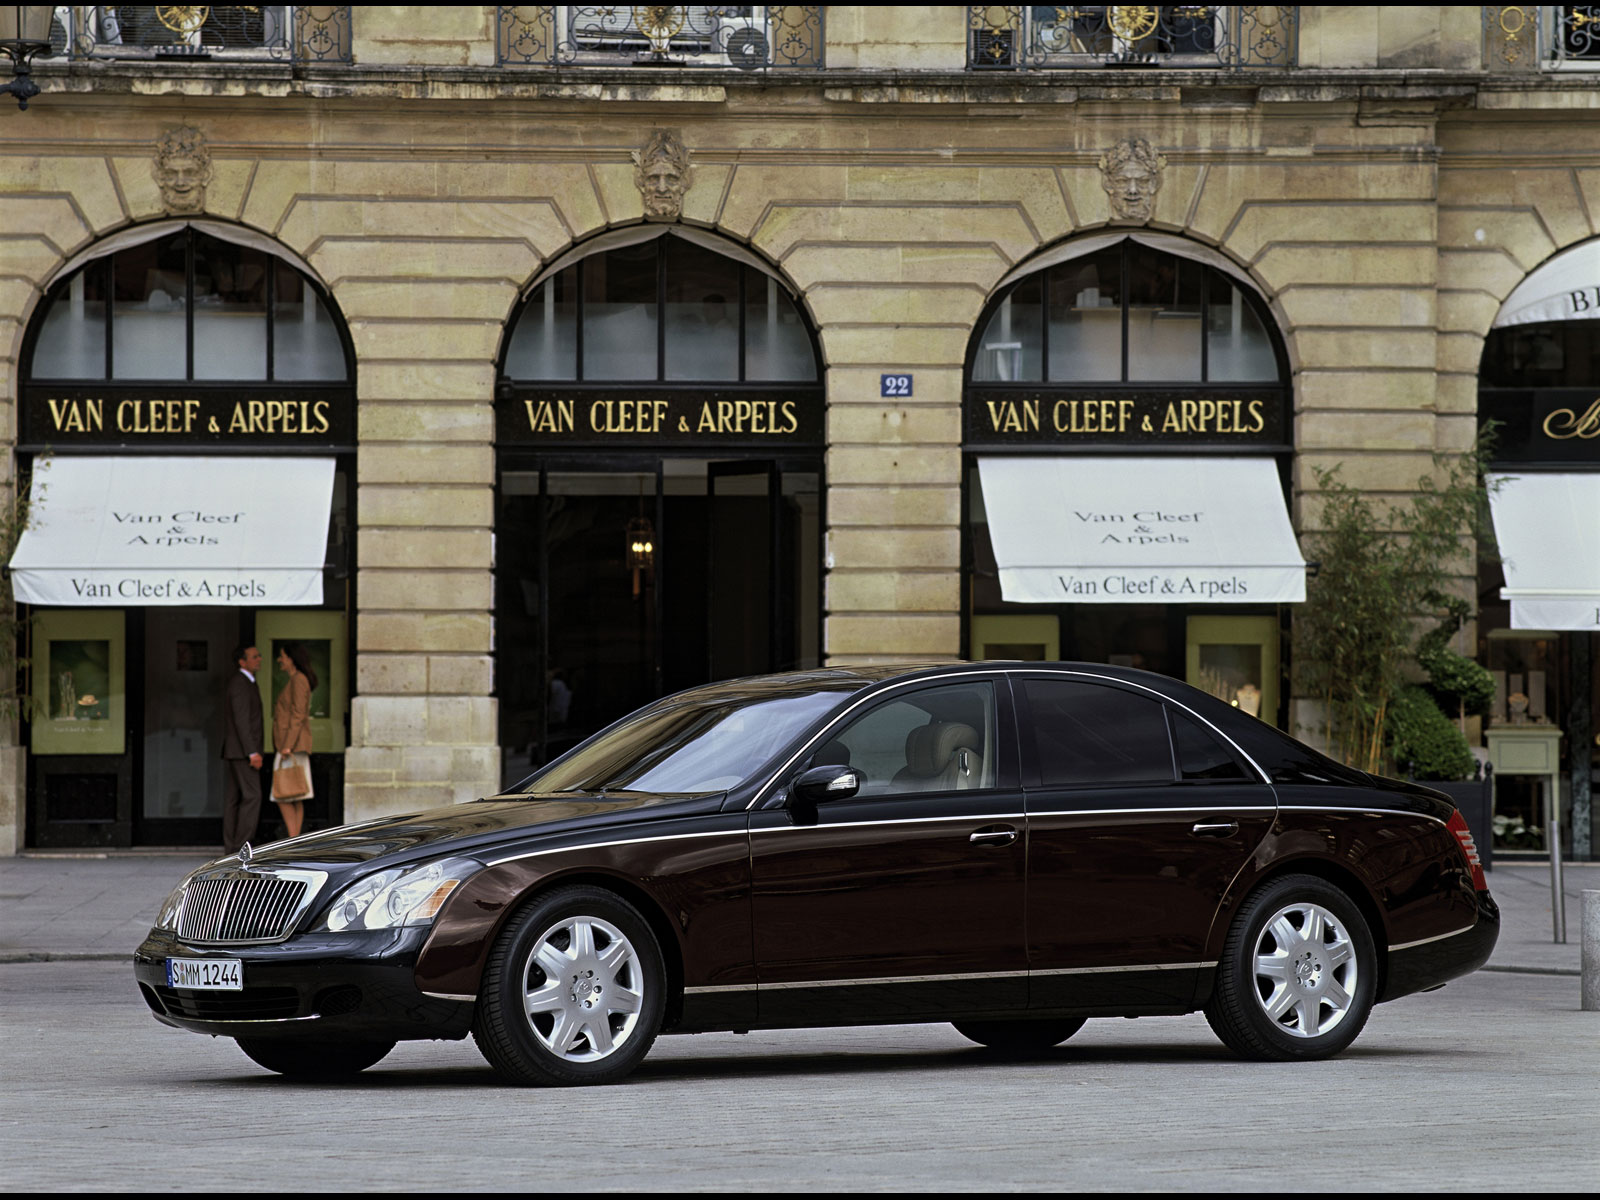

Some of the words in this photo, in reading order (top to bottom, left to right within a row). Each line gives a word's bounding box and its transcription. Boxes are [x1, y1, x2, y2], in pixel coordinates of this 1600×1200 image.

[885, 377, 909, 395] 22
[48, 399, 103, 433] VAN
[117, 400, 200, 433] CLEEF
[208, 415, 220, 433] &
[228, 400, 330, 434] ARPELS
[524, 400, 575, 433] VAN
[590, 400, 669, 433] CLEEF
[677, 415, 690, 433] &
[697, 401, 798, 434] ARPELS
[987, 400, 1040, 433] VAN
[1053, 400, 1135, 433] CLEEF
[1141, 415, 1154, 432] &
[1161, 400, 1265, 433] ARPELS
[112, 511, 162, 524] Van
[172, 511, 245, 524] Cleef
[1074, 511, 1124, 523] Van
[1133, 511, 1205, 523] Cleef
[167, 525, 186, 535] &
[1133, 524, 1154, 533] &
[127, 535, 219, 546] Arpels
[1100, 533, 1190, 545] Arpels
[71, 578, 112, 598] Van
[118, 578, 174, 598] Cleef
[177, 581, 192, 597] &
[195, 579, 266, 600] Arpels
[1057, 576, 1097, 595] Van
[1103, 575, 1158, 595] Cleef
[1160, 578, 1175, 594] &
[1179, 576, 1248, 598] Arpels
[203, 963, 239, 986] 1244
